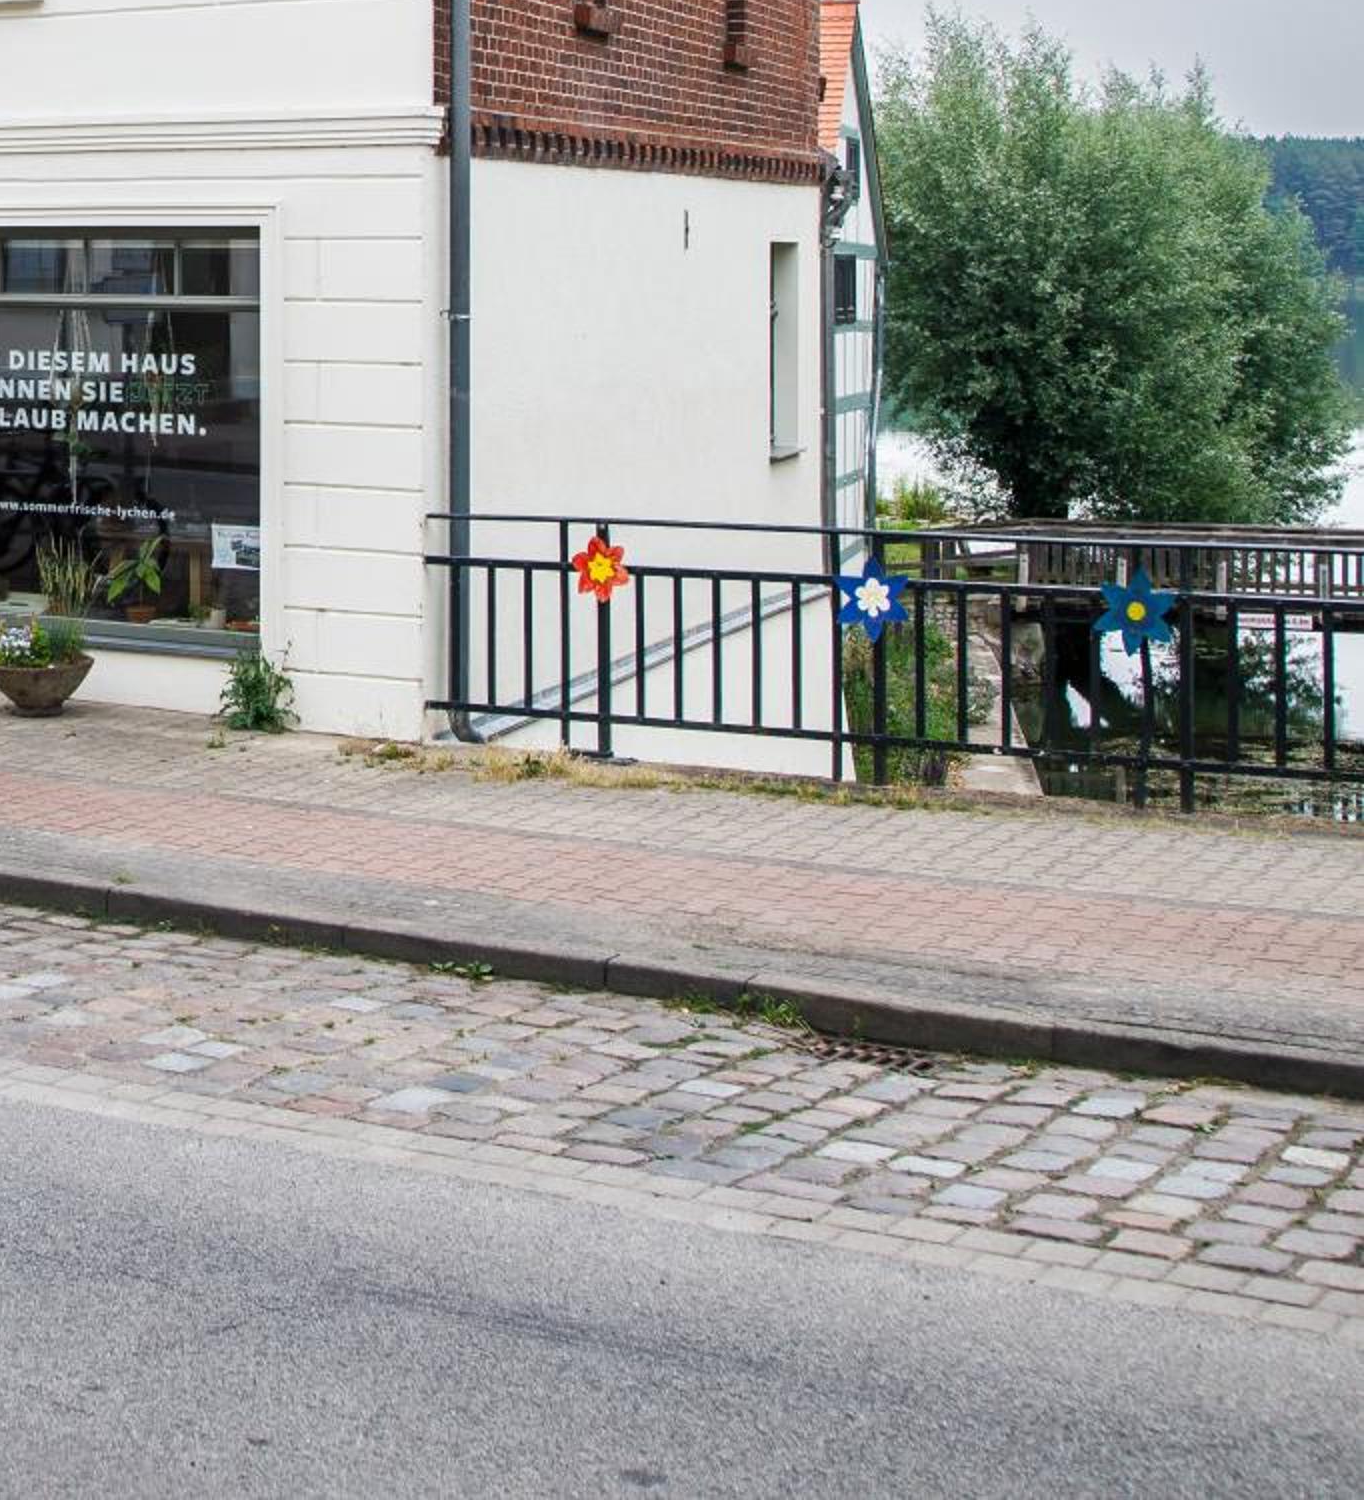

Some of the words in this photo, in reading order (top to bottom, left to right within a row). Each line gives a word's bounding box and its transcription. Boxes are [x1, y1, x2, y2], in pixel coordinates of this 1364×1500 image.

[9, 350, 110, 372] DIESEM
[121, 353, 196, 375] HAUS
[82, 382, 124, 402] SIE
[77, 411, 207, 436] MACHEN.
